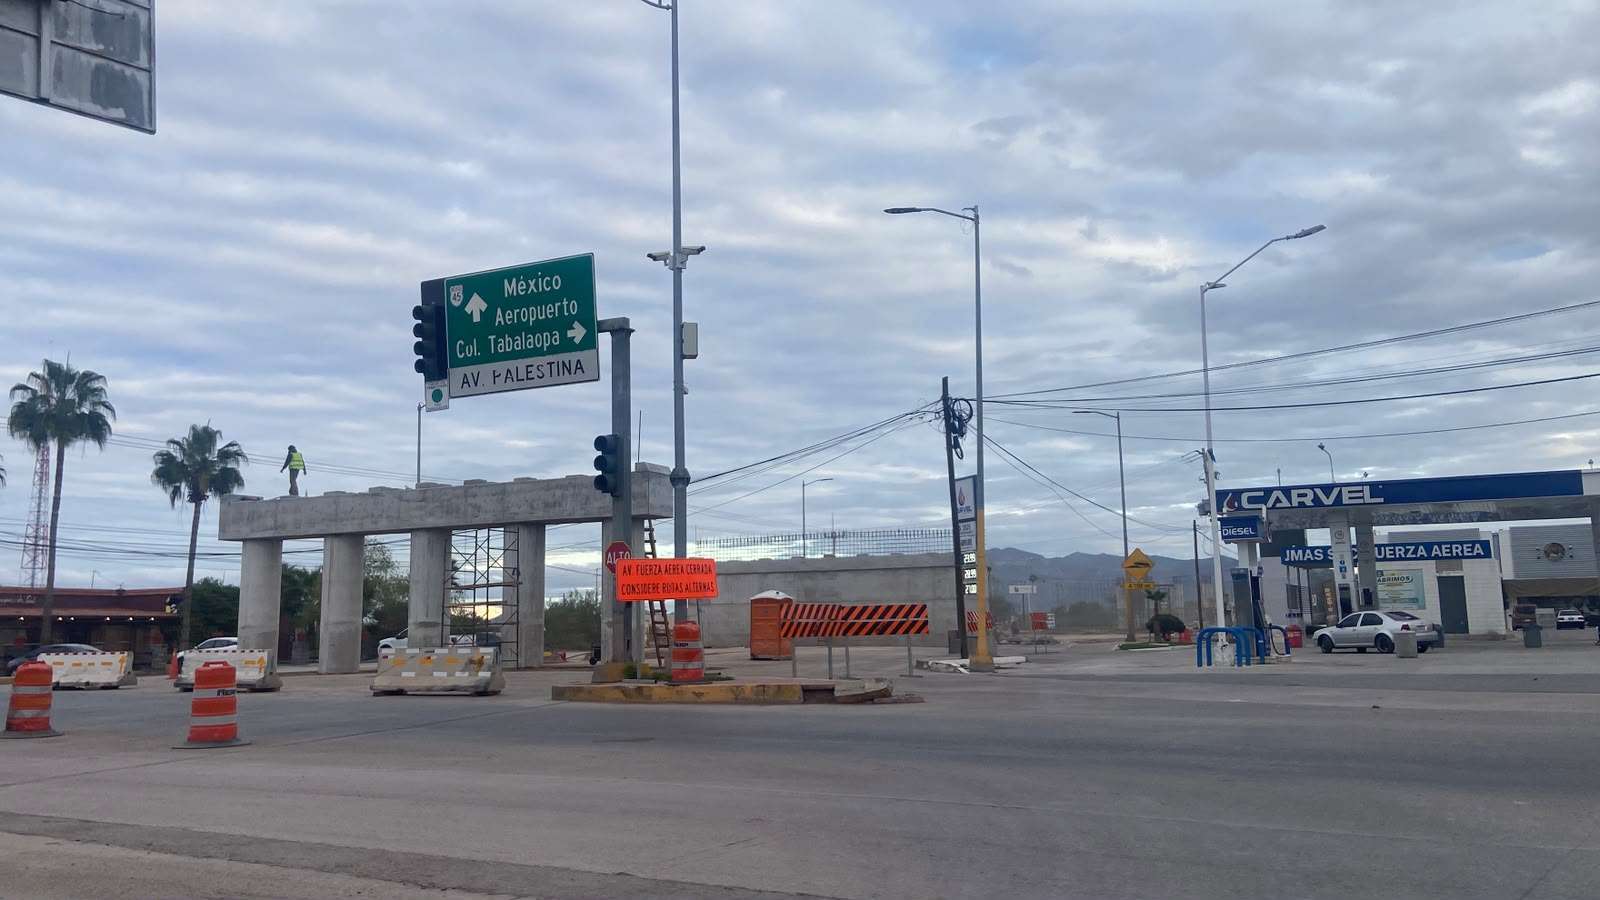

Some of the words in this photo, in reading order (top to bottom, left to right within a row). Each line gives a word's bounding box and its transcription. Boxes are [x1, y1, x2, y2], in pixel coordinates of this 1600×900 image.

[504, 272, 561, 298] México
[495, 298, 578, 326] Aeropuerto
[456, 338, 481, 358] Col.
[488, 330, 560, 354] Tabalaopa
[461, 371, 485, 389] AV.
[1241, 486, 1384, 509] CARVEL
[1222, 527, 1256, 536] DIESEL
[606, 551, 631, 565] ALTO
[1285, 548, 1323, 562] JMAS
[1375, 545, 1427, 559] UERZA
[1431, 543, 1484, 557] AEREA
[636, 564, 662, 576] FUERZA
[665, 563, 685, 575] AEREA
[687, 562, 713, 575] CERRADA
[621, 583, 660, 596] CONSIDERE
[685, 580, 715, 593] ALTERNAS
